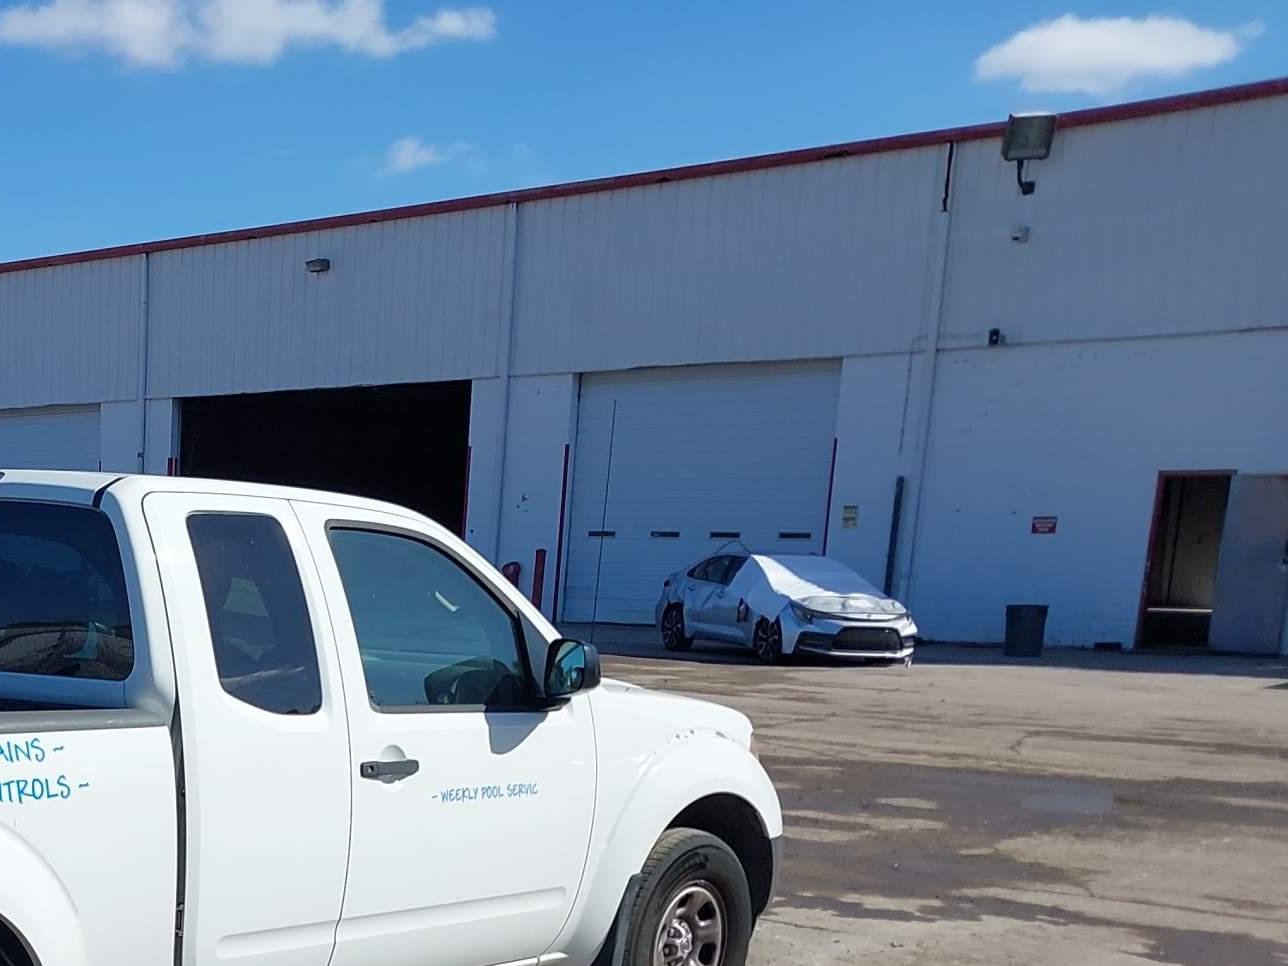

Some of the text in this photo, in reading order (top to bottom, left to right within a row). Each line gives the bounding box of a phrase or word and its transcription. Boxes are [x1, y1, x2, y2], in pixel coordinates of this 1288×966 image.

[440, 786, 479, 803] WEEKLY
[481, 785, 504, 799] POOL
[506, 783, 538, 798] SERVIC
